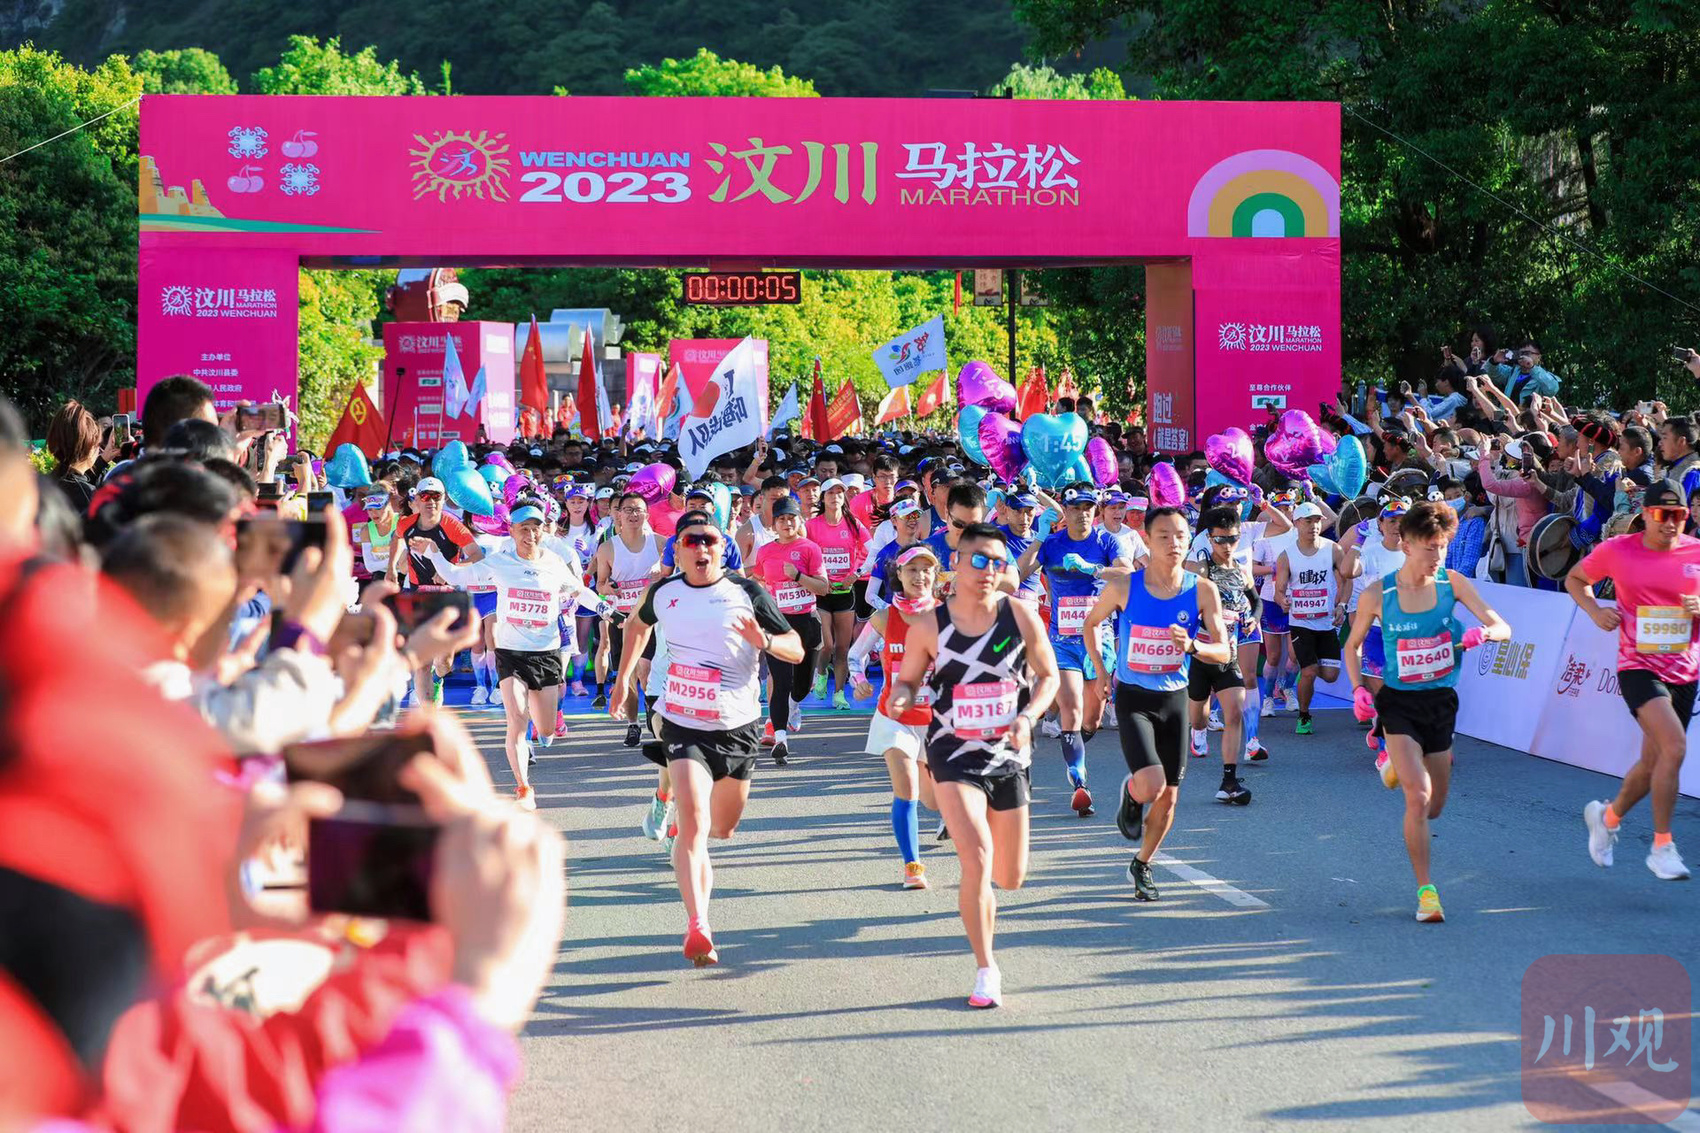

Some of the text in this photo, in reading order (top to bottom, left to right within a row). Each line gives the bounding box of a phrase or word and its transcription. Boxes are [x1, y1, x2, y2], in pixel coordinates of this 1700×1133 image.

[519, 151, 690, 168] WENCHUAN
[703, 136, 1082, 206] 汶川 马拉松
[519, 171, 692, 203] 2023
[900, 188, 1080, 207] MARATHON
[688, 275, 796, 300] 00:00:05
[194, 287, 277, 309] 汶川 马拉松
[196, 309, 277, 318] 2023 WENCHUAN
[1248, 324, 1321, 344] 汶川 马拉松
[201, 353, 231, 361] 主办单位
[1250, 343, 1322, 352] 2023 WENCHUAN
[193, 368, 238, 377] 中共汶川县委
[1249, 383, 1291, 391] 至尊合作伙伴
[1041, 431, 1084, 453] 1:45
[778, 588, 812, 602] M5305
[1294, 599, 1327, 609] M4947
[509, 601, 549, 614] M3778
[1400, 647, 1451, 667] M2640
[669, 680, 717, 701] M2956
[957, 700, 1013, 719] M3187
